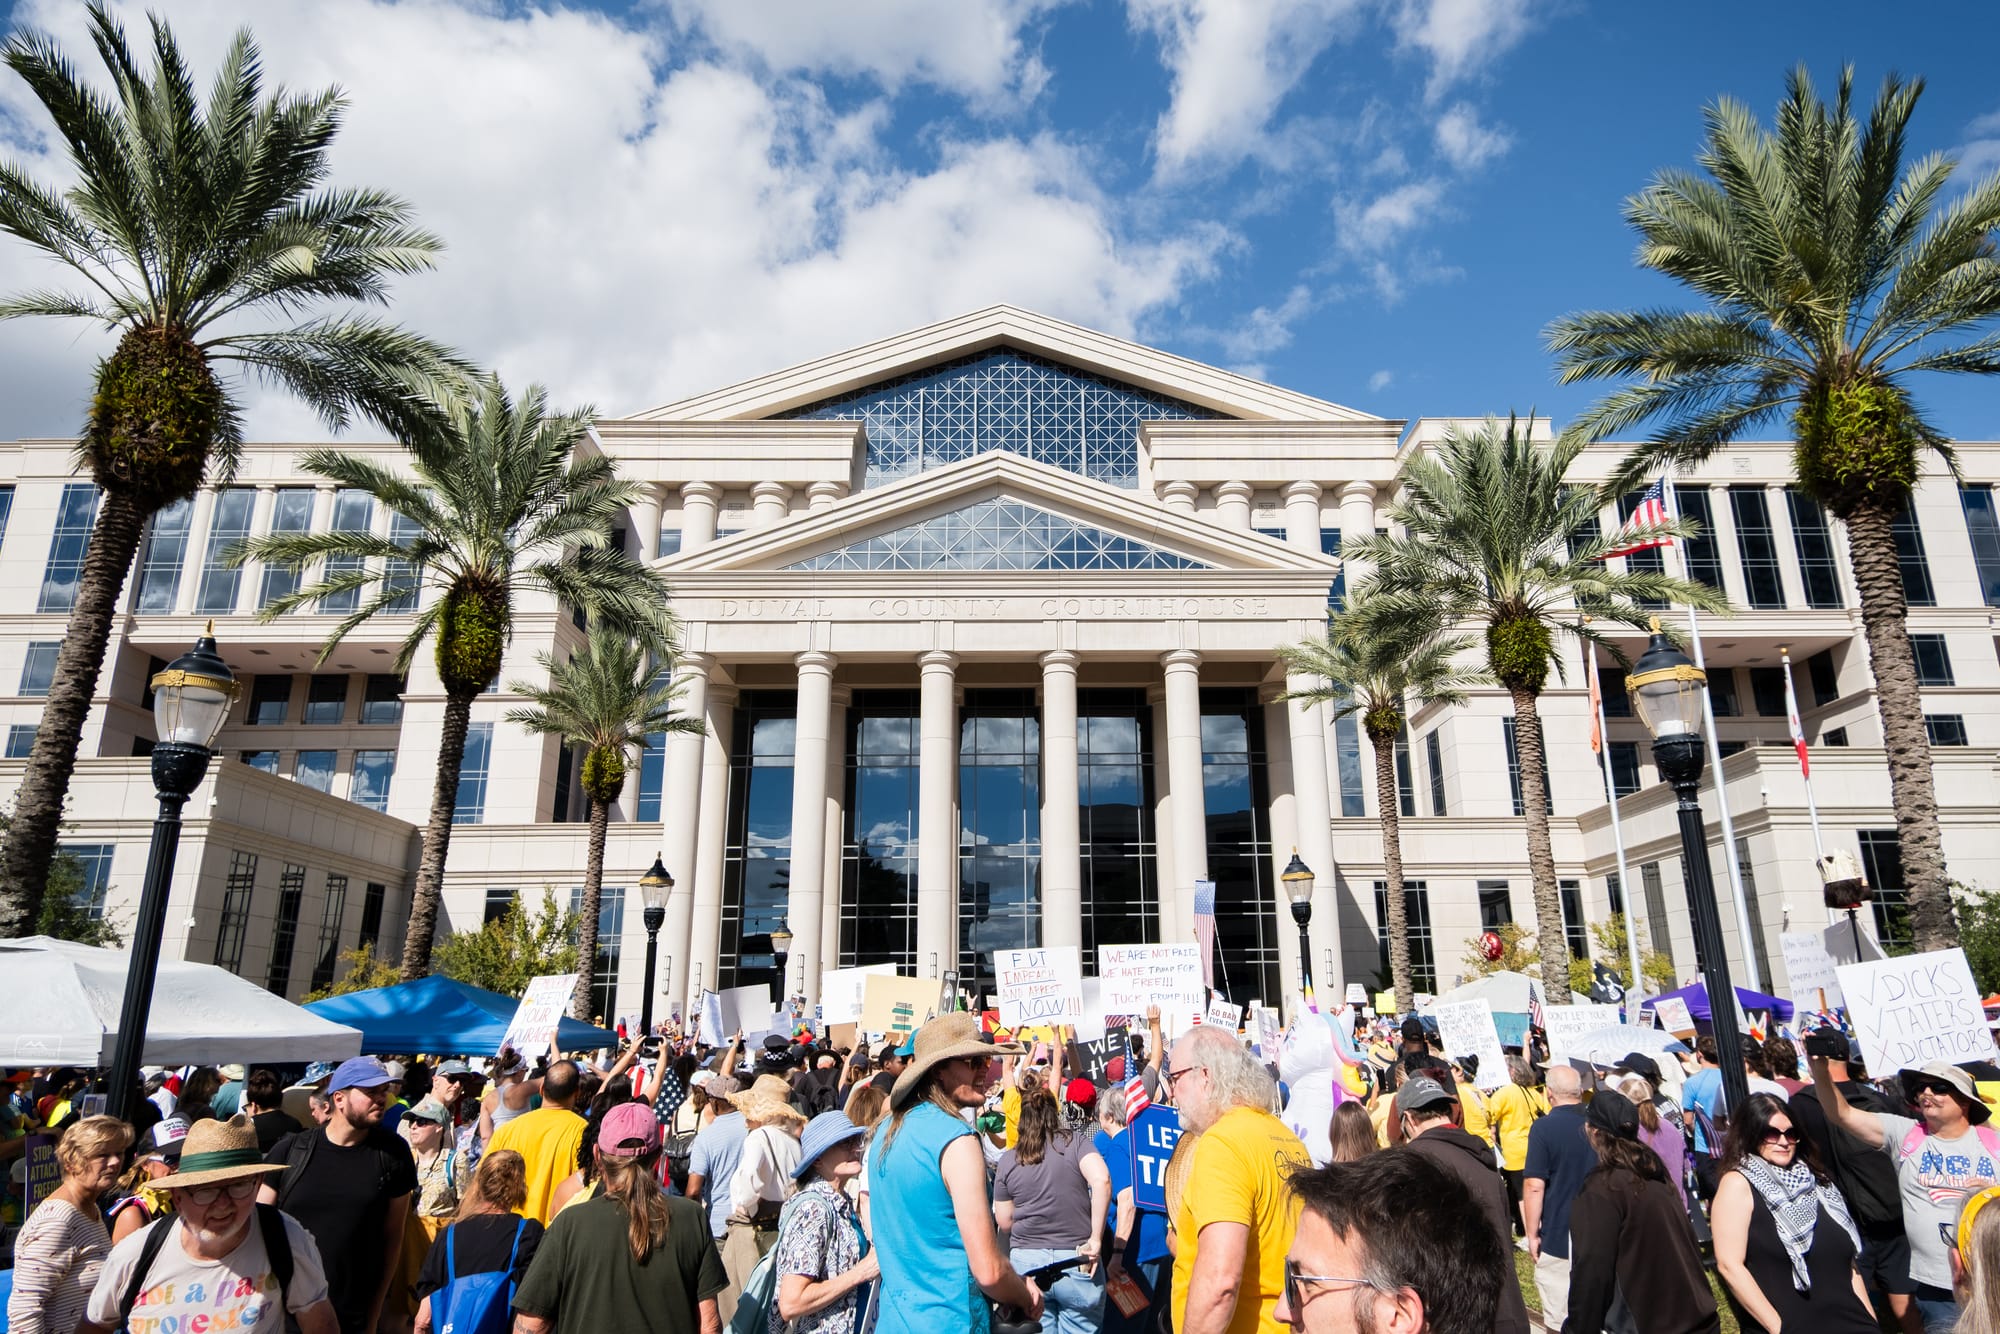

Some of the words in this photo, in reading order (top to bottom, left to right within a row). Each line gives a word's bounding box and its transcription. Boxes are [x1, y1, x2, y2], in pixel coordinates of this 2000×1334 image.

[720, 599, 832, 616] DUVAL
[868, 599, 1007, 616] COUNTY
[1041, 598, 1269, 616] COURTHOUSE
[1106, 949, 1126, 963] WE
[1127, 949, 1148, 960] ARE
[1152, 948, 1170, 958] NOT
[1002, 969, 1054, 985] IMPEACH
[1101, 967, 1118, 979] WE
[1122, 966, 1145, 977] HATE
[1148, 965, 1175, 974] TRUMP
[1177, 964, 1195, 973] FOR
[1132, 976, 1173, 988] FREE!!!
[1881, 961, 1962, 1001] DICKS
[1002, 987, 1023, 1000] AND
[1112, 993, 1143, 1005] TUCK
[524, 1007, 551, 1022] YOUR
[1211, 1008, 1220, 1017] SO
[1572, 1010, 1584, 1020] LET
[1588, 1009, 1608, 1020] YOUR
[1886, 999, 1975, 1035] TATERS
[1209, 1017, 1223, 1026] EVEN
[1225, 1019, 1236, 1029] THE
[1554, 1022, 1586, 1034] COMFORT
[1088, 1033, 1121, 1055] WE
[1896, 1027, 1993, 1064] DICTATORS
[33, 1145, 52, 1162] STOP
[1919, 1151, 1996, 1187] USA
[133, 1282, 176, 1306] not
[185, 1282, 207, 1303] a
